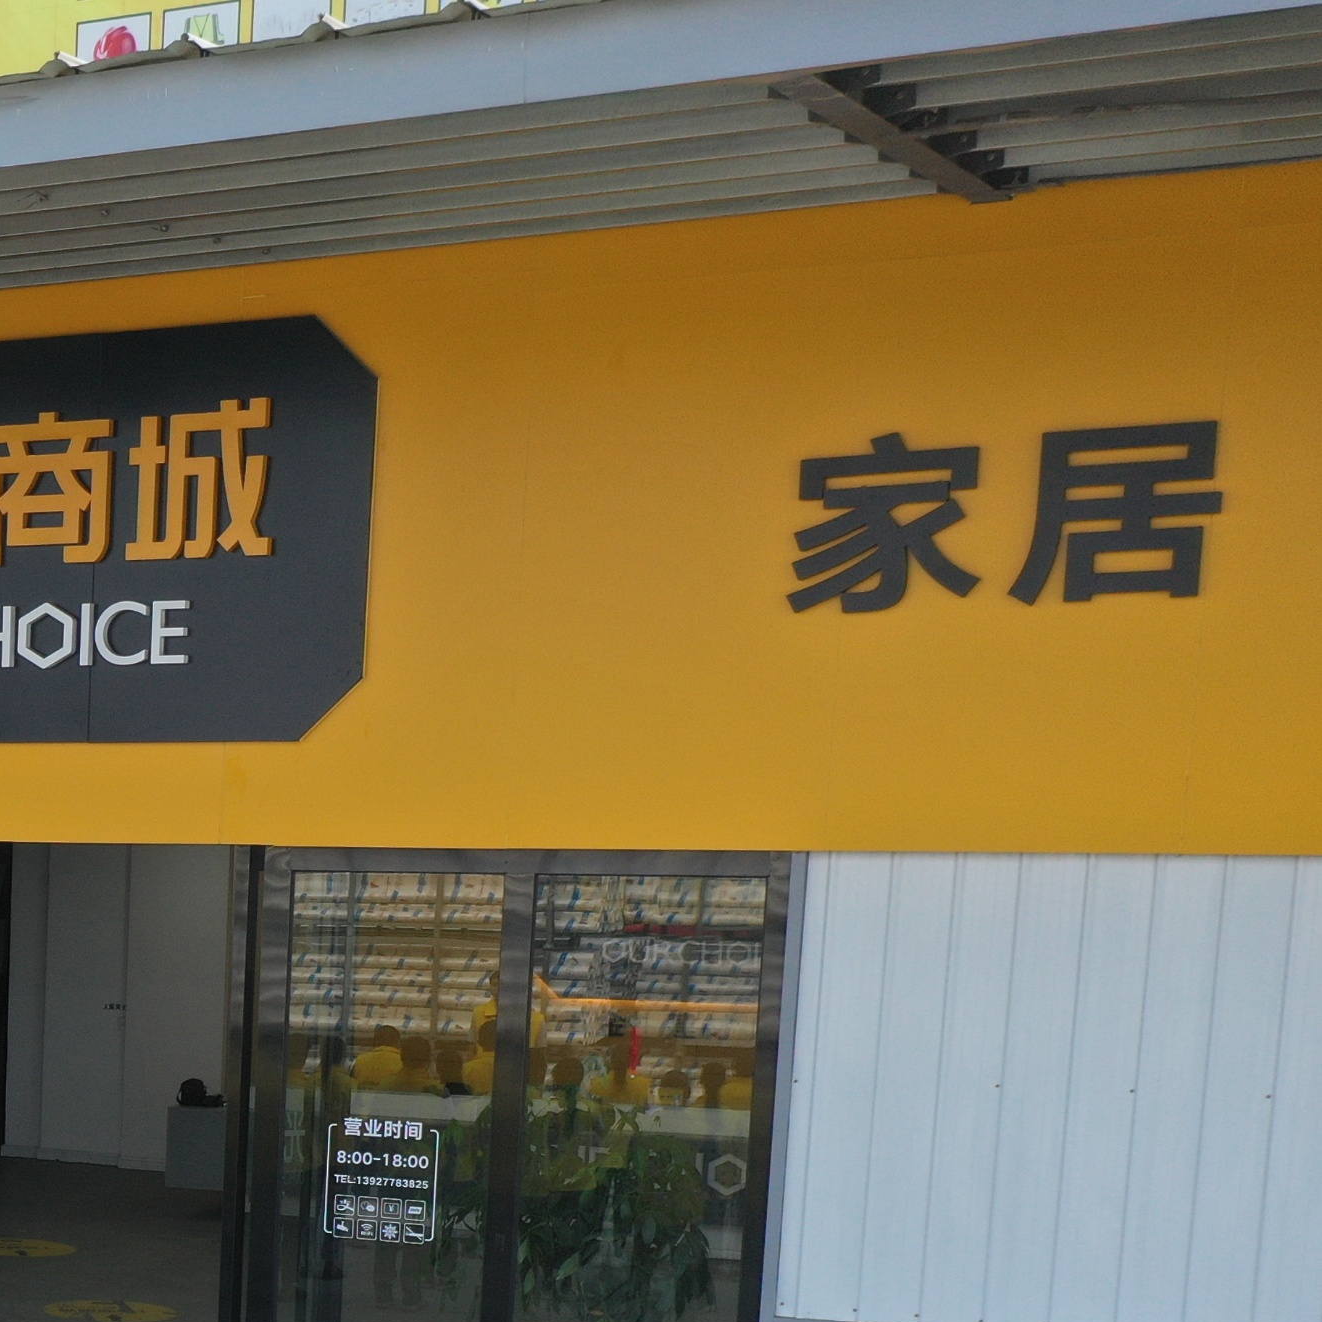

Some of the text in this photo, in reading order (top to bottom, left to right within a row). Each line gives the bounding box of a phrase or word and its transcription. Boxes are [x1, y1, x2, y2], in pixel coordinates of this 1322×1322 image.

[786, 420, 1224, 614] 家居
[344, 1117, 423, 1141] 营业时间
[336, 1150, 429, 1169] 8:00-18:00
[334, 1174, 429, 1190] TEL:13927783825
